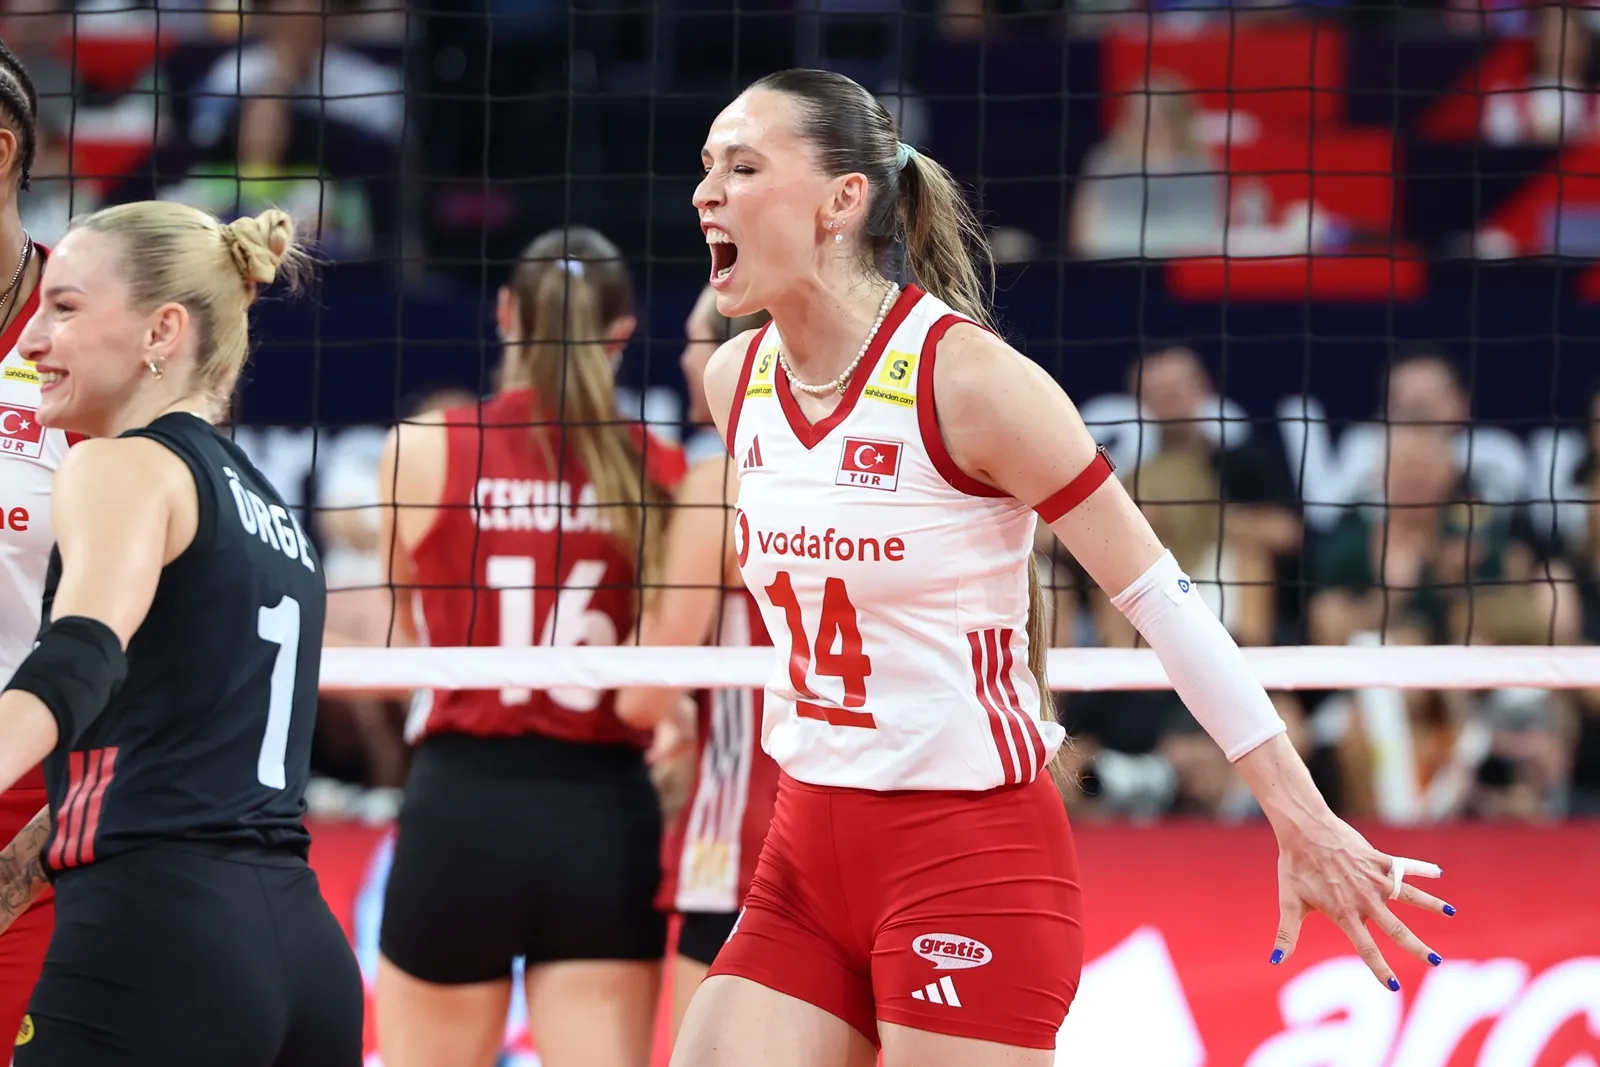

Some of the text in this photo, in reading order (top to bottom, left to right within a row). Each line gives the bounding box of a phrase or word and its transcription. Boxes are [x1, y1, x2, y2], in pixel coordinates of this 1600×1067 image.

[889, 359, 909, 380] S
[864, 388, 914, 405] sahibinden.com
[850, 472, 881, 486] TUR
[469, 477, 613, 533] CEKULA
[757, 526, 906, 562] vodafone
[486, 555, 618, 712] 16
[764, 571, 872, 707] 14
[257, 594, 300, 791] 1
[919, 938, 986, 960] gratis
